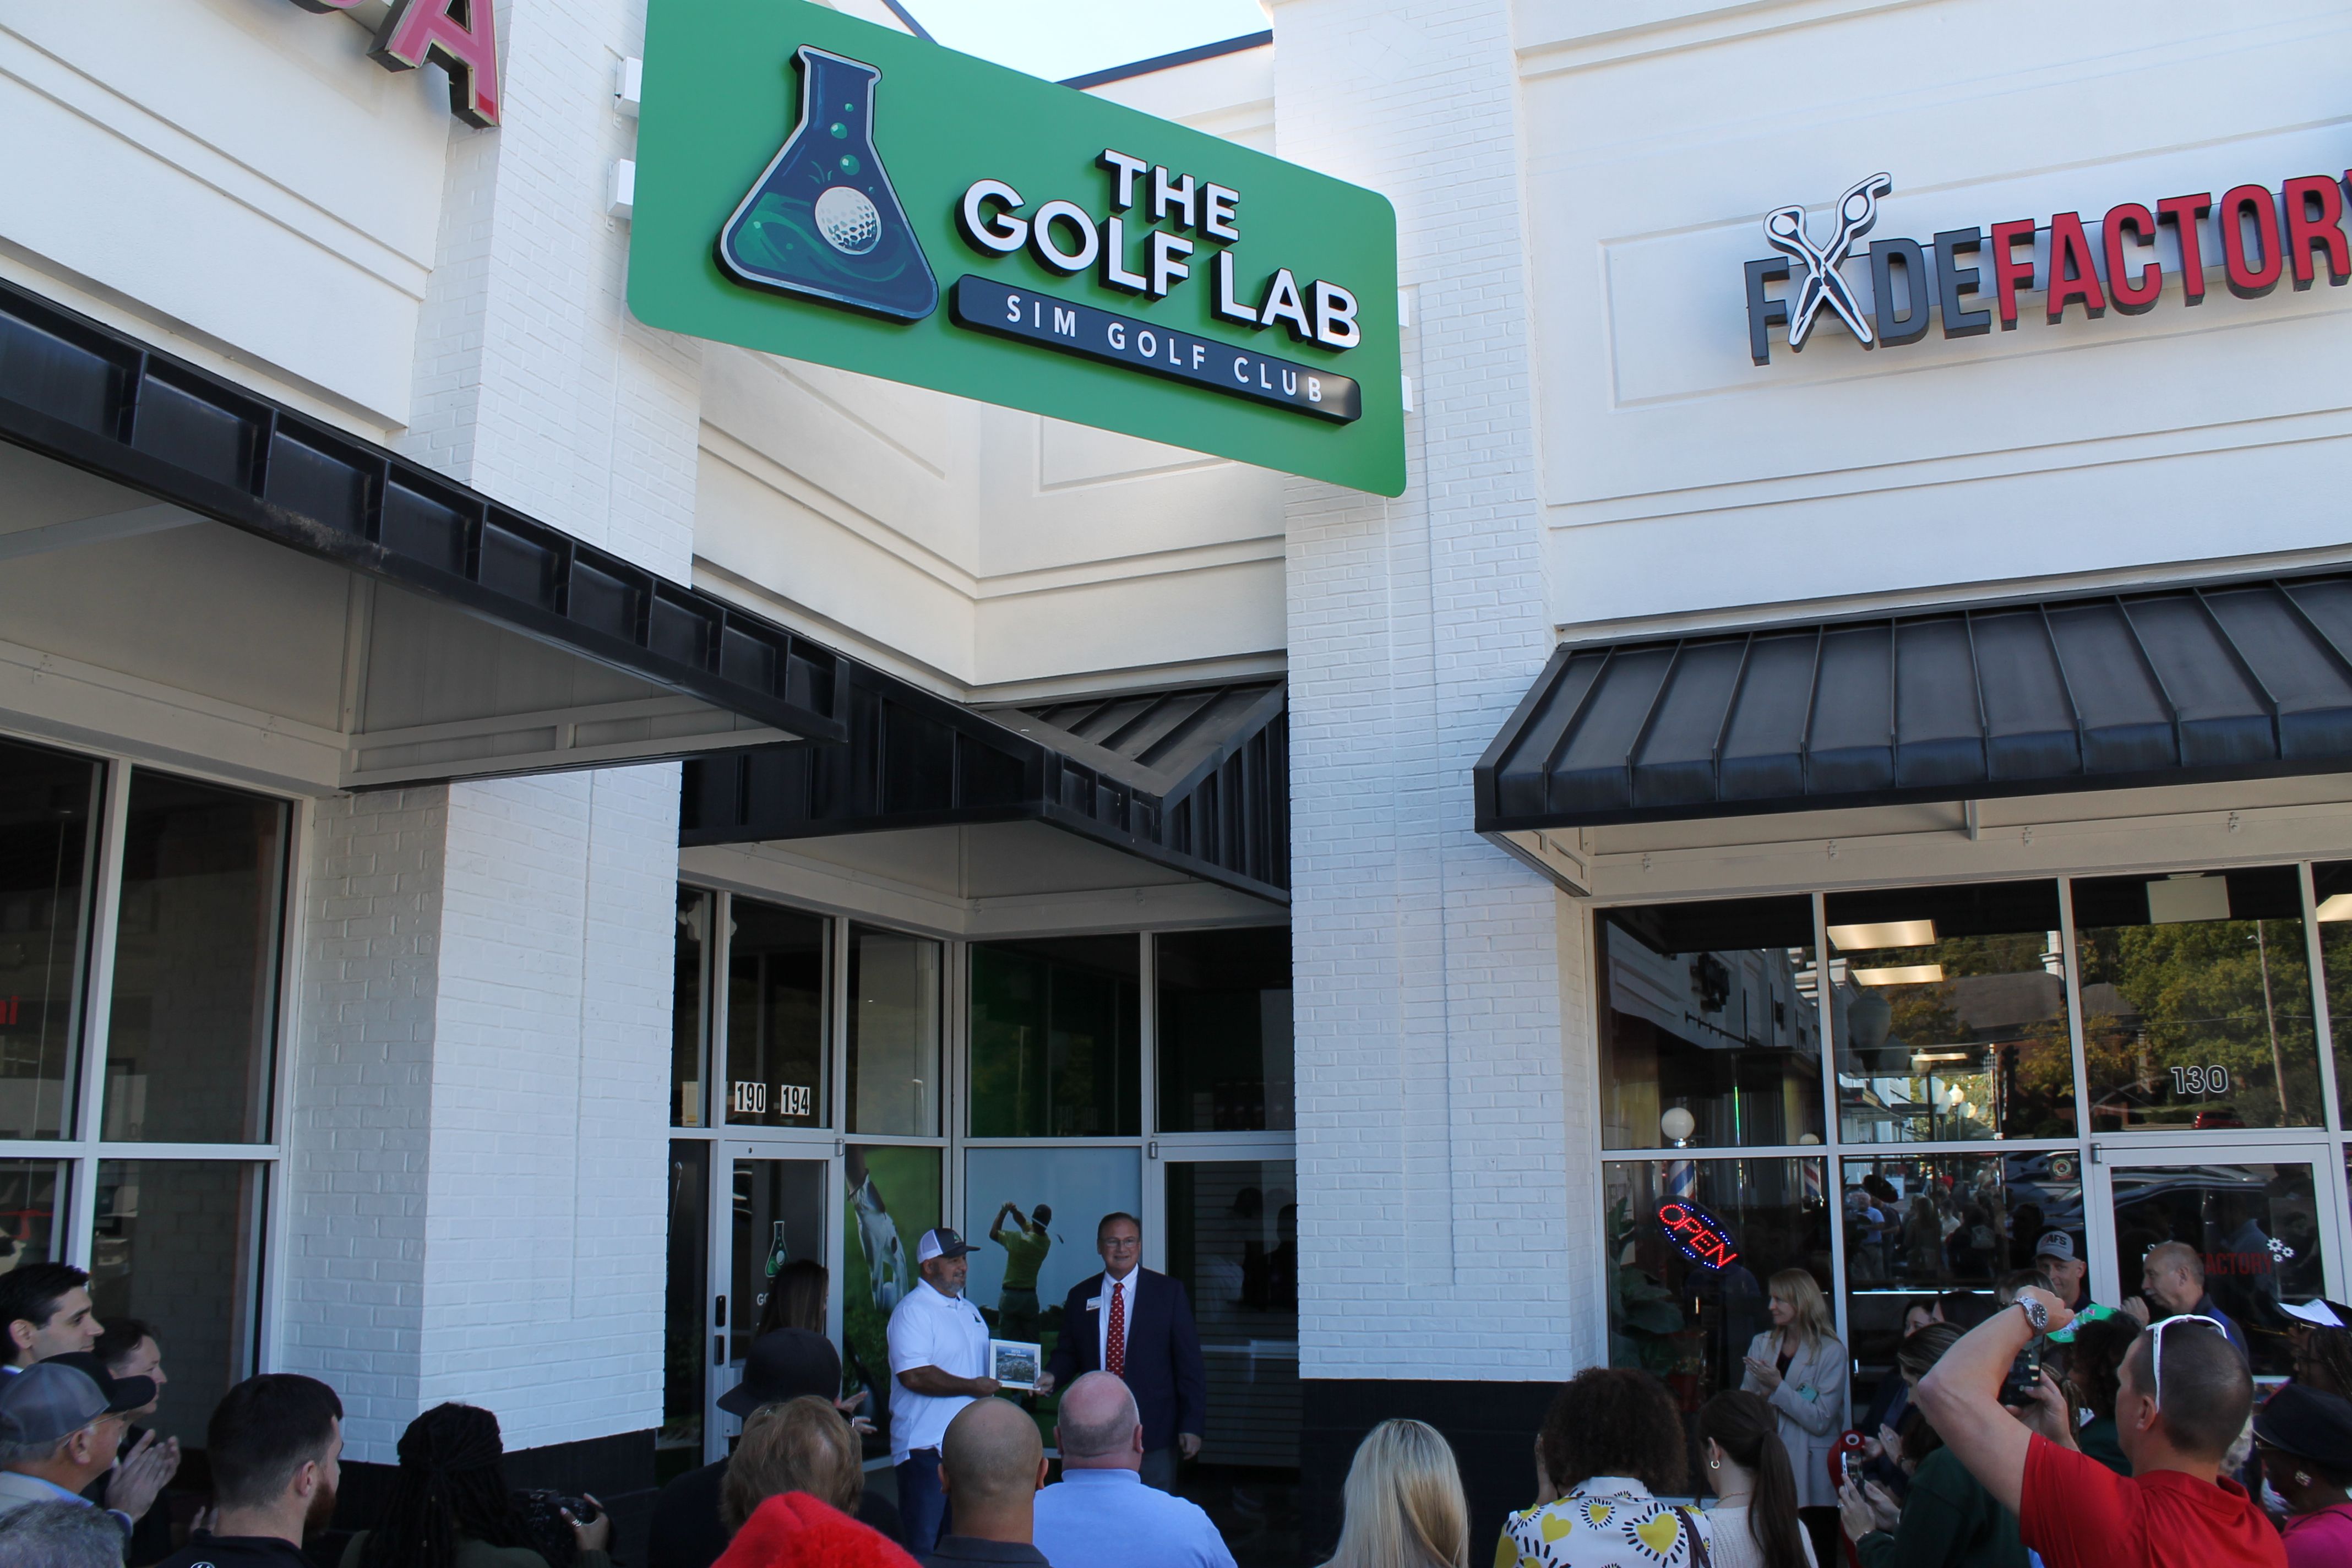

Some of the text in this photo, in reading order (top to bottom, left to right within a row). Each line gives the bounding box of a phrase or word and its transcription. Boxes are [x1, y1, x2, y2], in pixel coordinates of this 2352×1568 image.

[1097, 148, 1240, 246] THE
[956, 178, 1362, 352] GOLF LAB
[1006, 295, 1322, 403] SIM GOLF CLUB
[738, 1083, 808, 1114] 190 194
[2170, 1065, 2228, 1094] 130
[1659, 1204, 1738, 1267] OPEN
